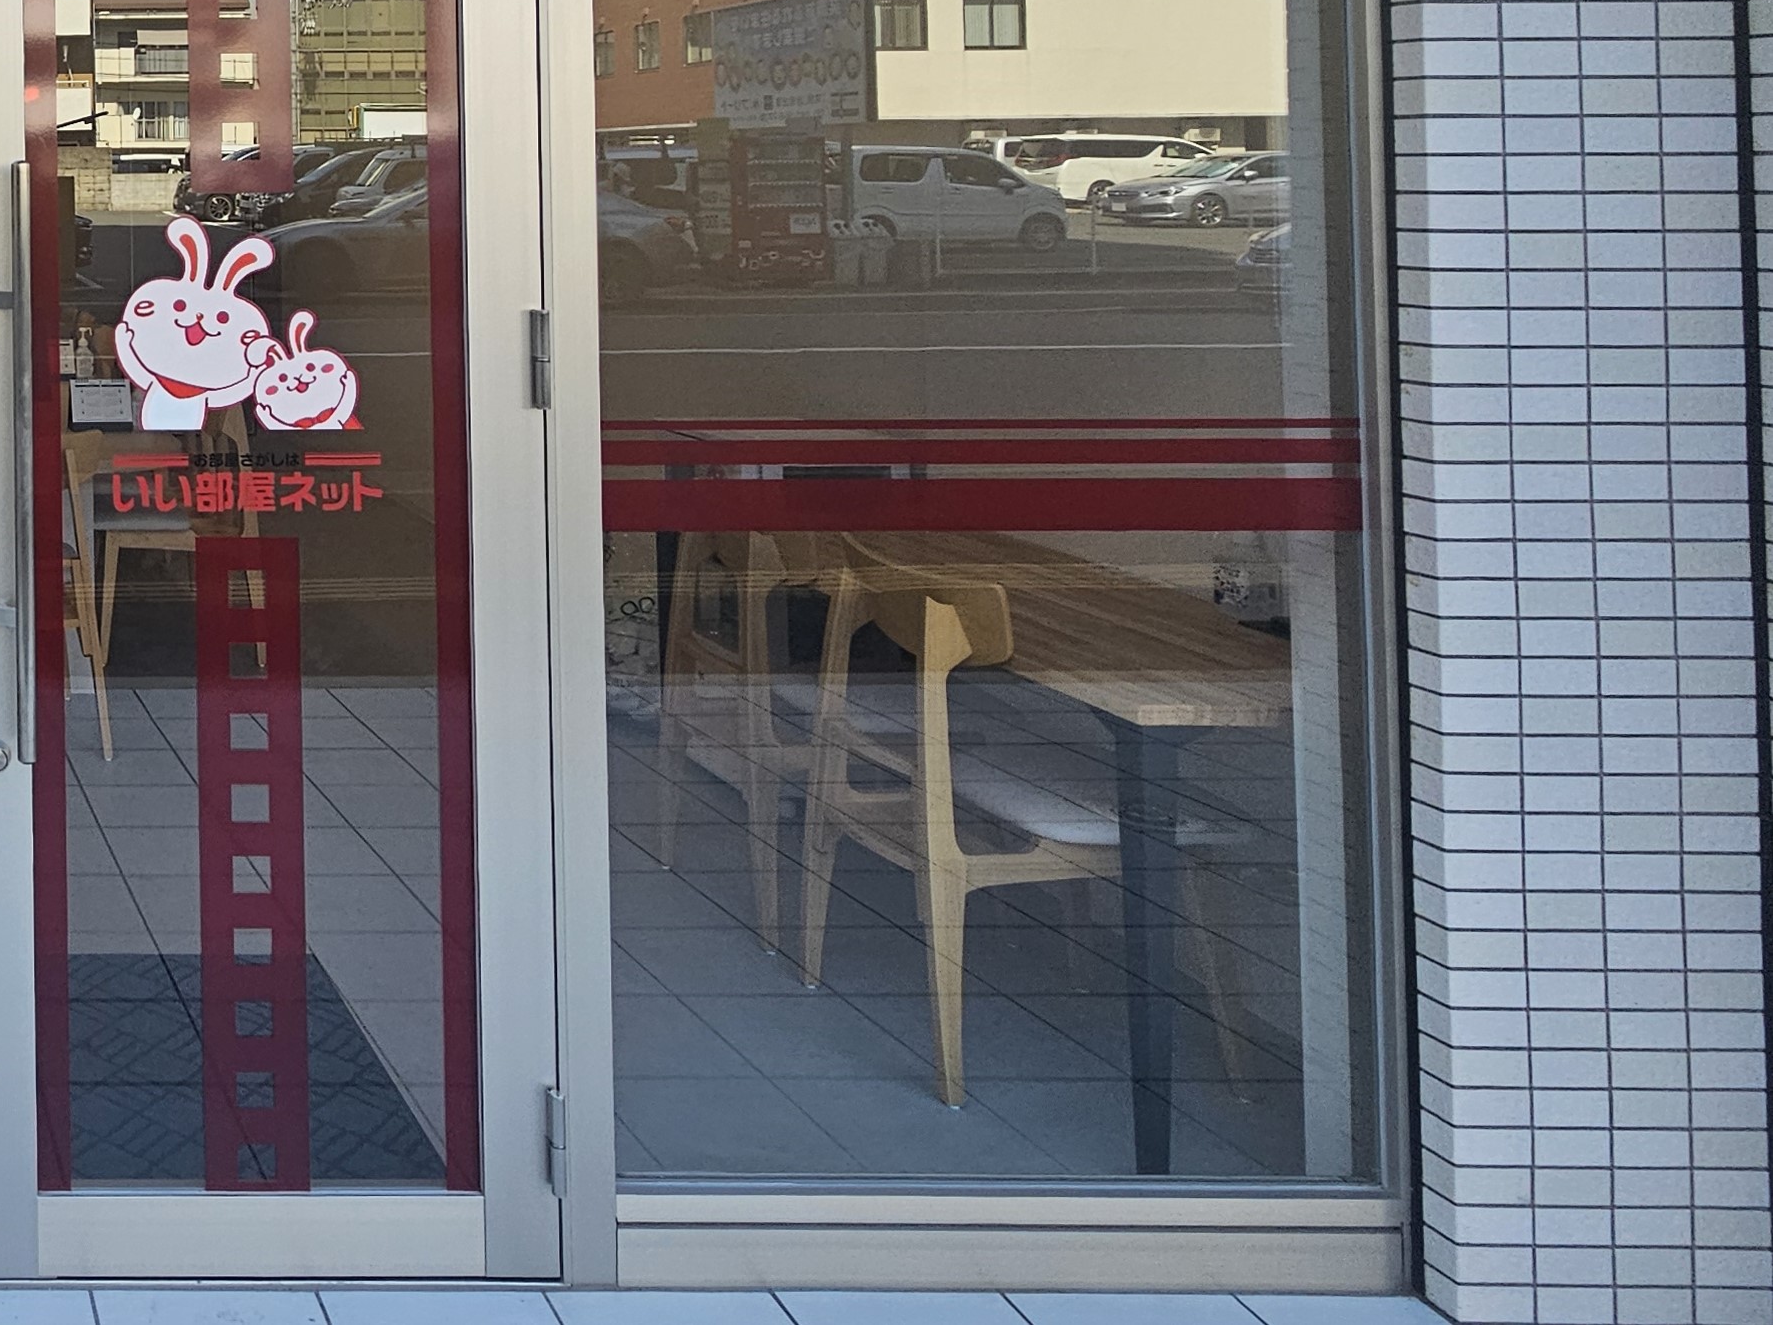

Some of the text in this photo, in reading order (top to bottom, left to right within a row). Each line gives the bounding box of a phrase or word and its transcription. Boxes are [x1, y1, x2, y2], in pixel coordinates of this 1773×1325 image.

[192, 452, 300, 468] お部屋さがしは
[111, 471, 384, 513] いい部屋ネット
